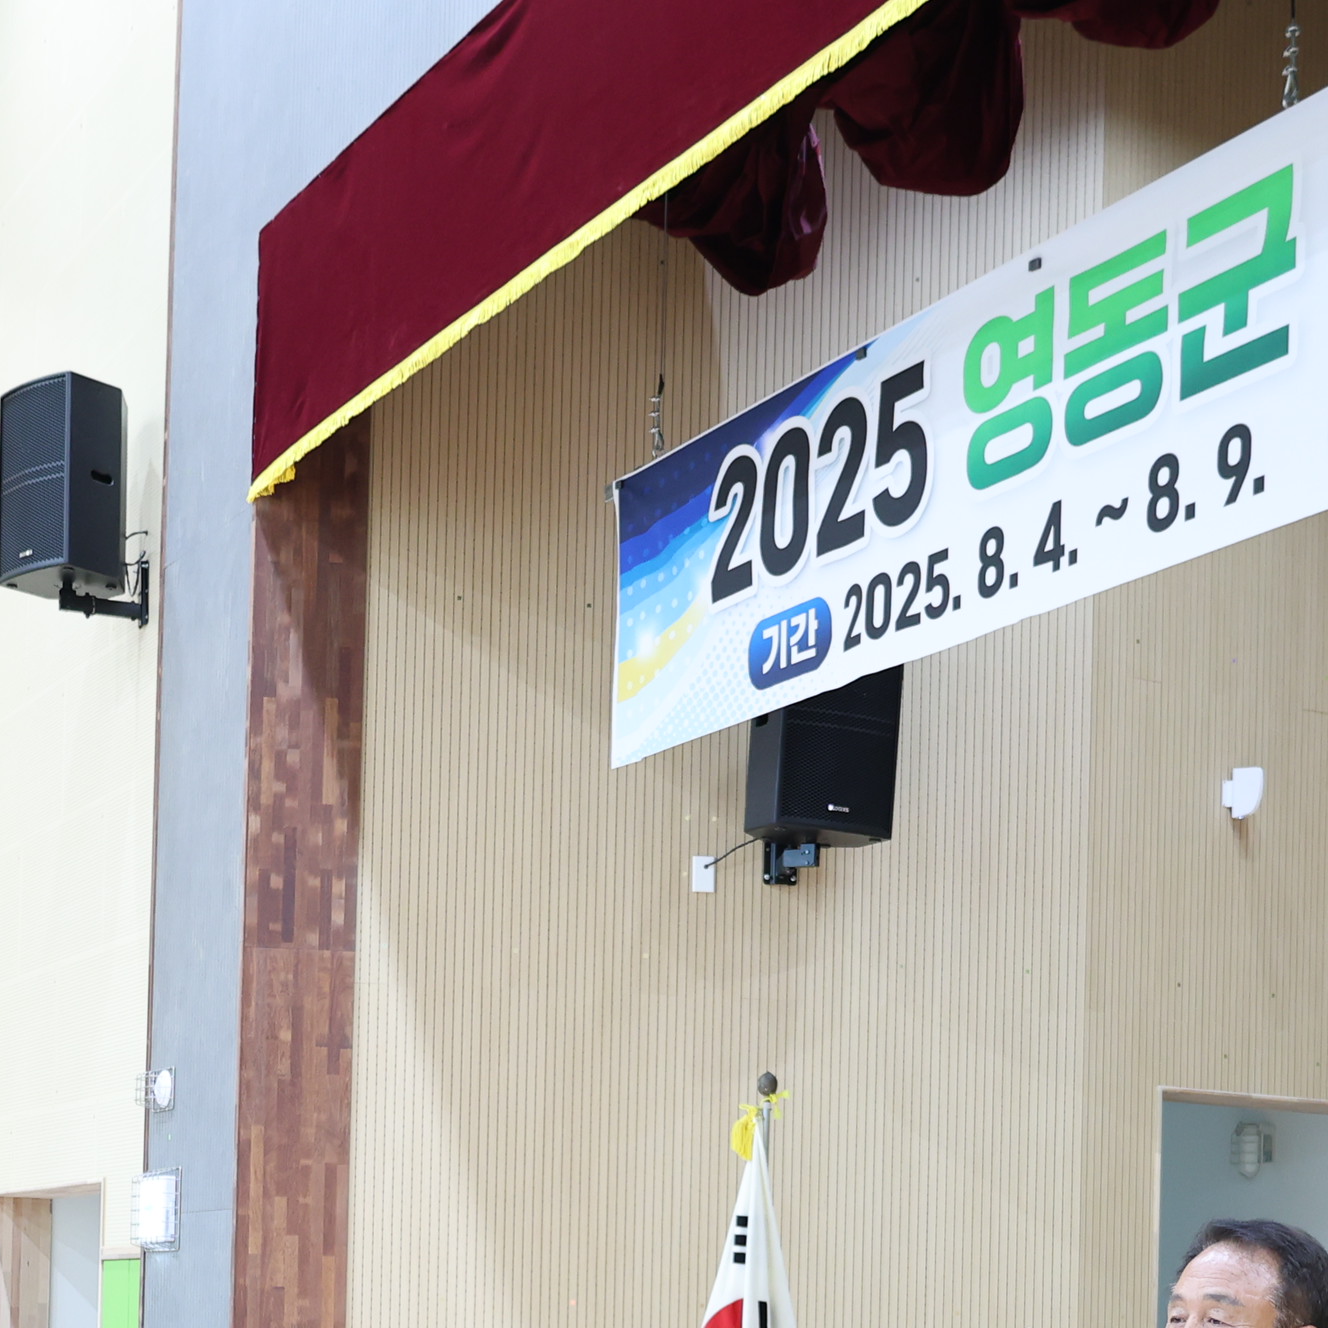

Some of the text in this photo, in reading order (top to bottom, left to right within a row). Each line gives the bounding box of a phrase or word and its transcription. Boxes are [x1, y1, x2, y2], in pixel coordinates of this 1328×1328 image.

[710, 360, 929, 605] 2025
[963, 163, 1298, 491] 영동군
[761, 616, 821, 671] 기간
[843, 549, 962, 653] 2025.
